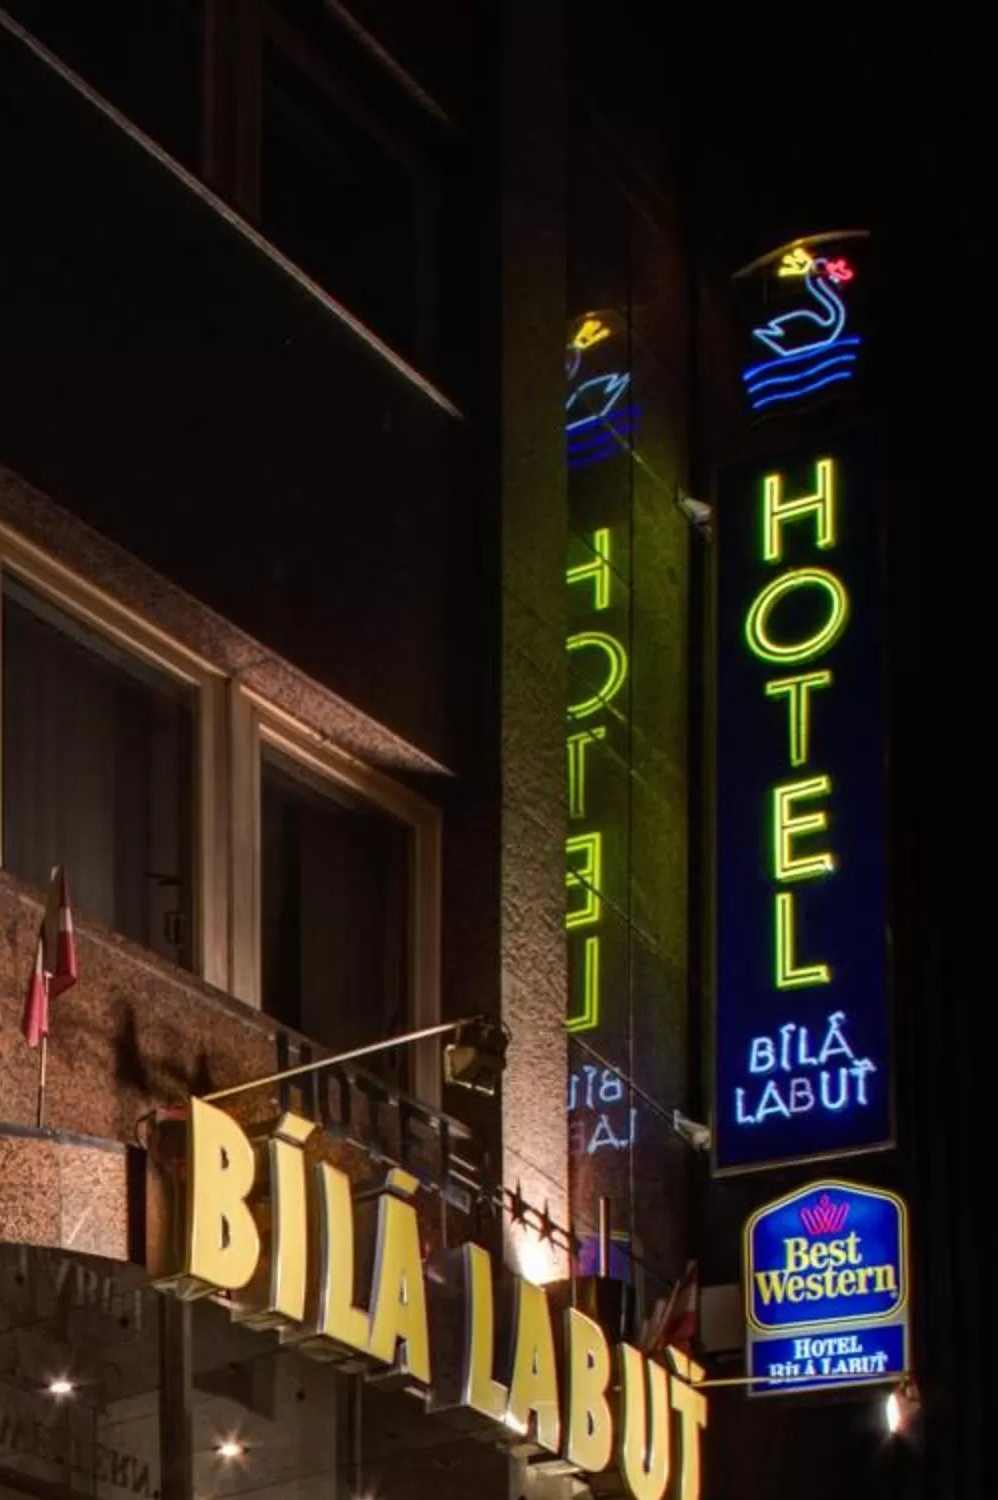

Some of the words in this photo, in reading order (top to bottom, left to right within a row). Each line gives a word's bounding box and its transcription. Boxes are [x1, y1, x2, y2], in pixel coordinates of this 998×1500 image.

[744, 457, 850, 990] HOTEL
[189, 1096, 432, 1398] BÍLÁ
[784, 1232, 863, 1273] Best
[755, 1262, 898, 1306] Western
[793, 1335, 863, 1360] HOTEL
